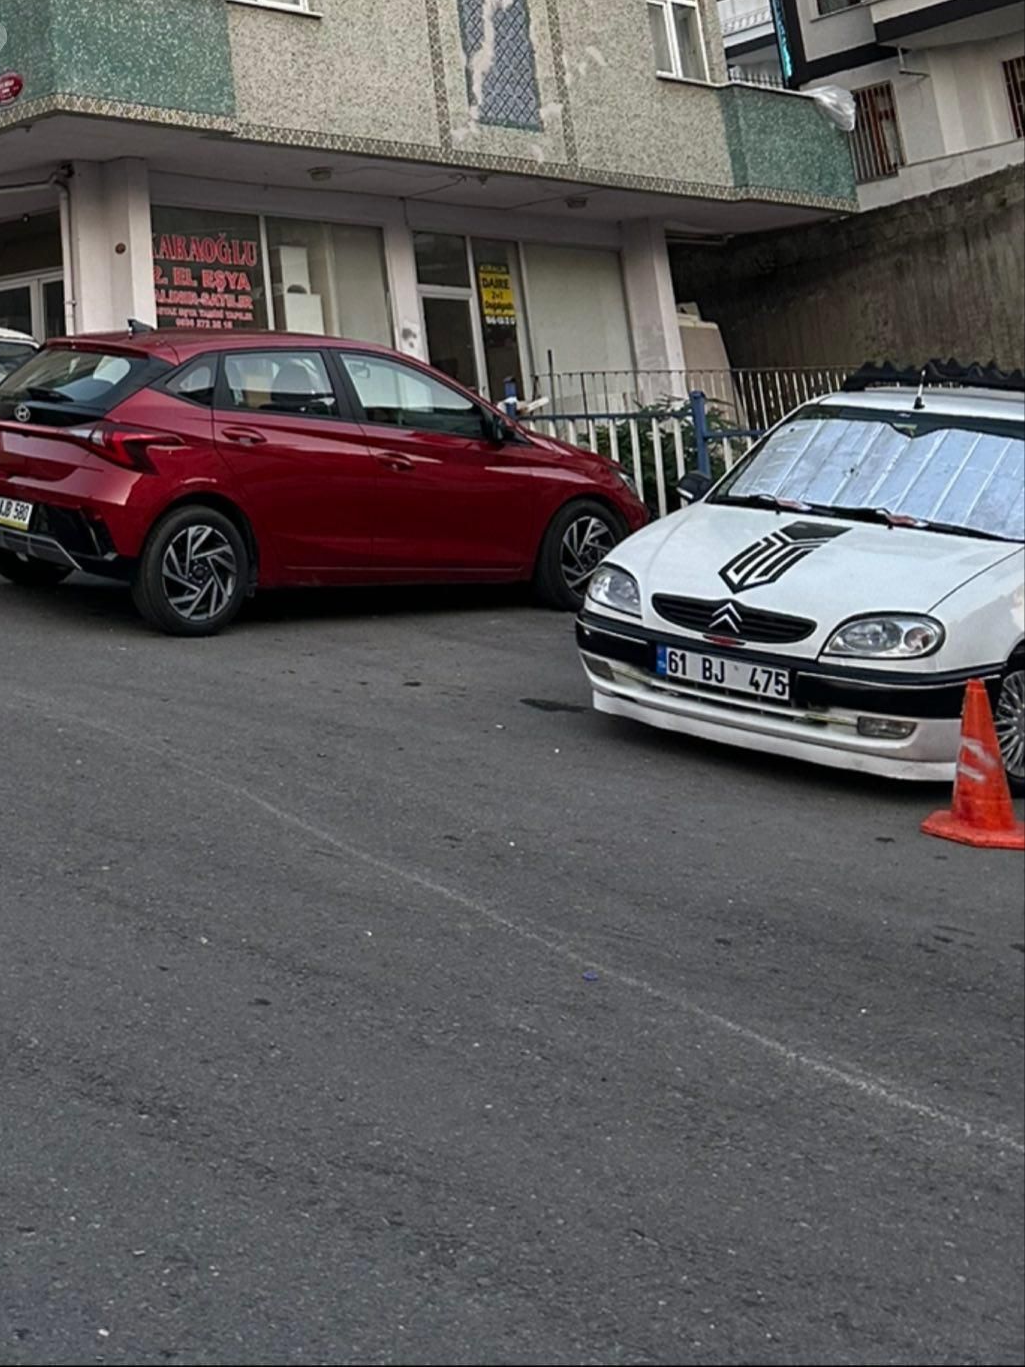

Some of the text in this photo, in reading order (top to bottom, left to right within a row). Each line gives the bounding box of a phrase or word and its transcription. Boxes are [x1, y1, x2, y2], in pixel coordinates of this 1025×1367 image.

[172, 266, 198, 287] EL
[201, 269, 252, 294] EŞYA
[668, 650, 789, 696] 61 BJ 475
